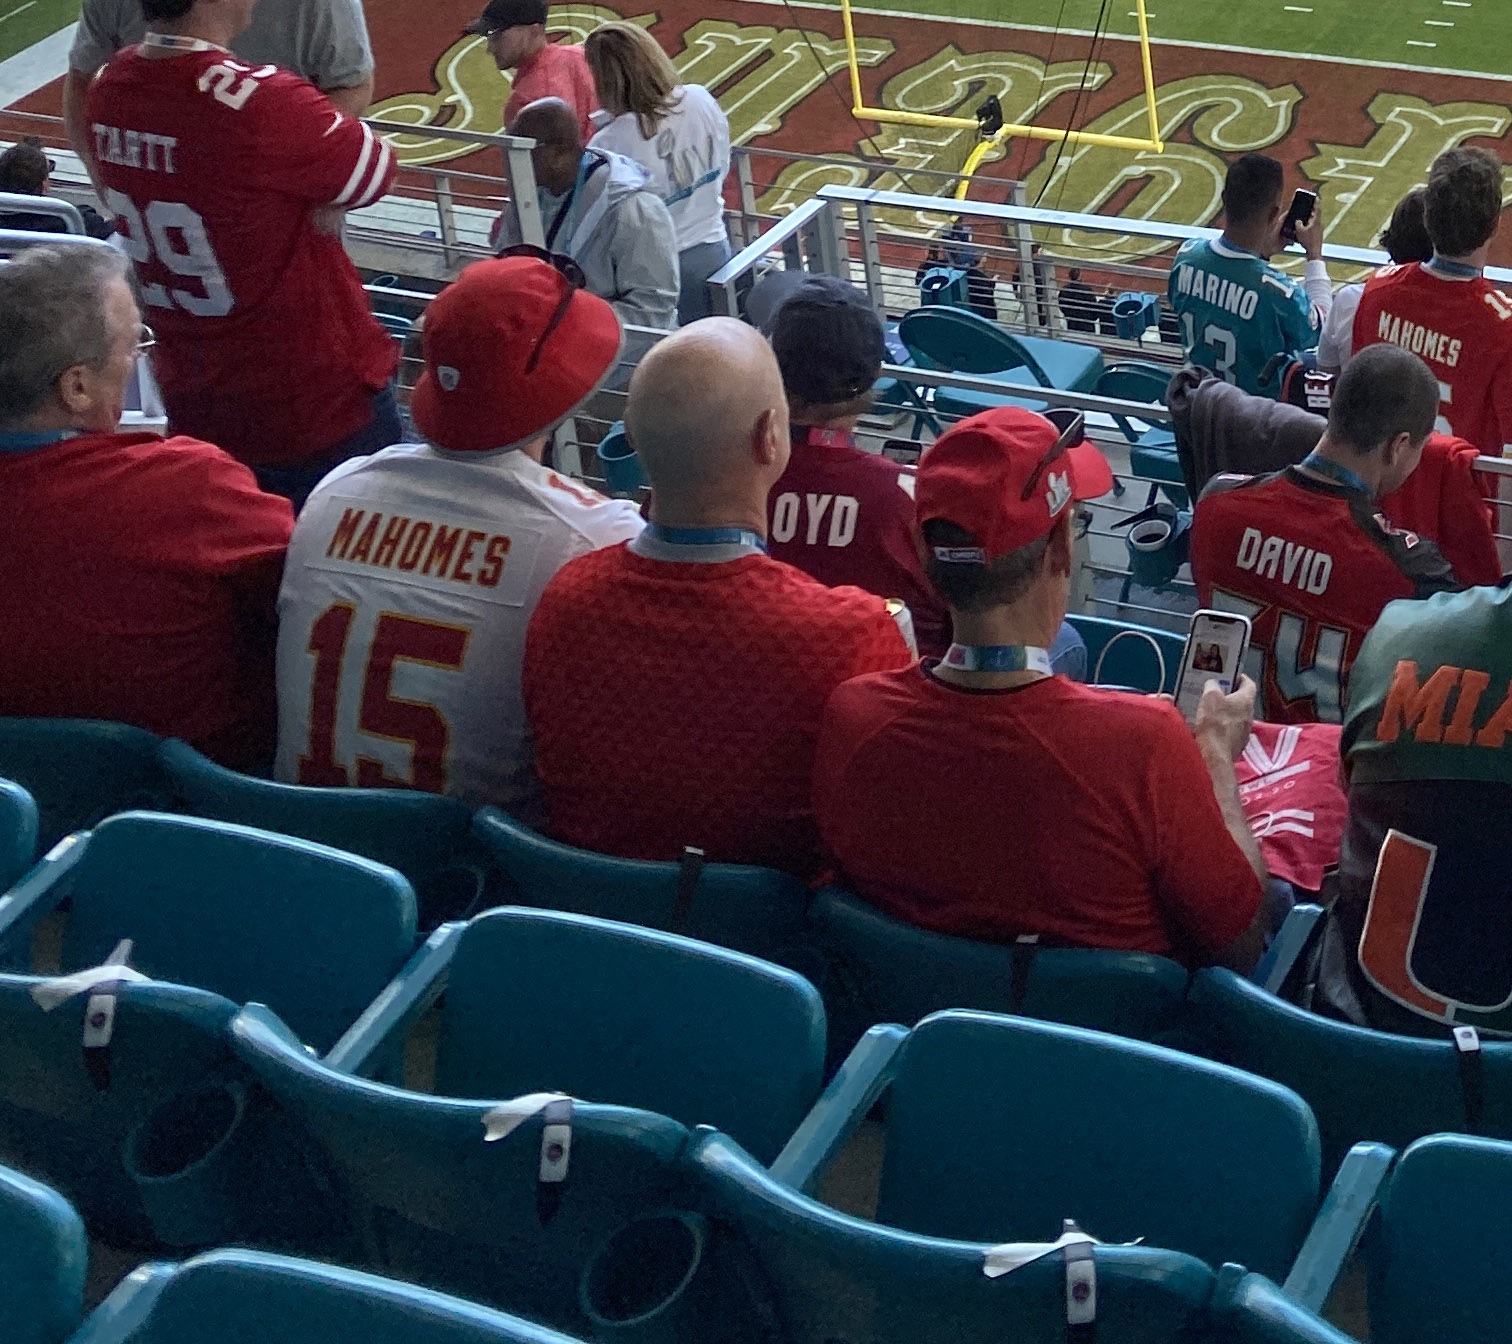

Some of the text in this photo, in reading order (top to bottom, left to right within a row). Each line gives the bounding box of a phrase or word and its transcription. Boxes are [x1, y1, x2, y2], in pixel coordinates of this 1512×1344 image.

[1177, 263, 1260, 321] MARINO
[1378, 309, 1463, 368] MAHOMES
[326, 506, 512, 590] MAHOMES
[771, 492, 860, 548] OYD
[1235, 526, 1334, 598] DAVID
[297, 601, 472, 794] 15
